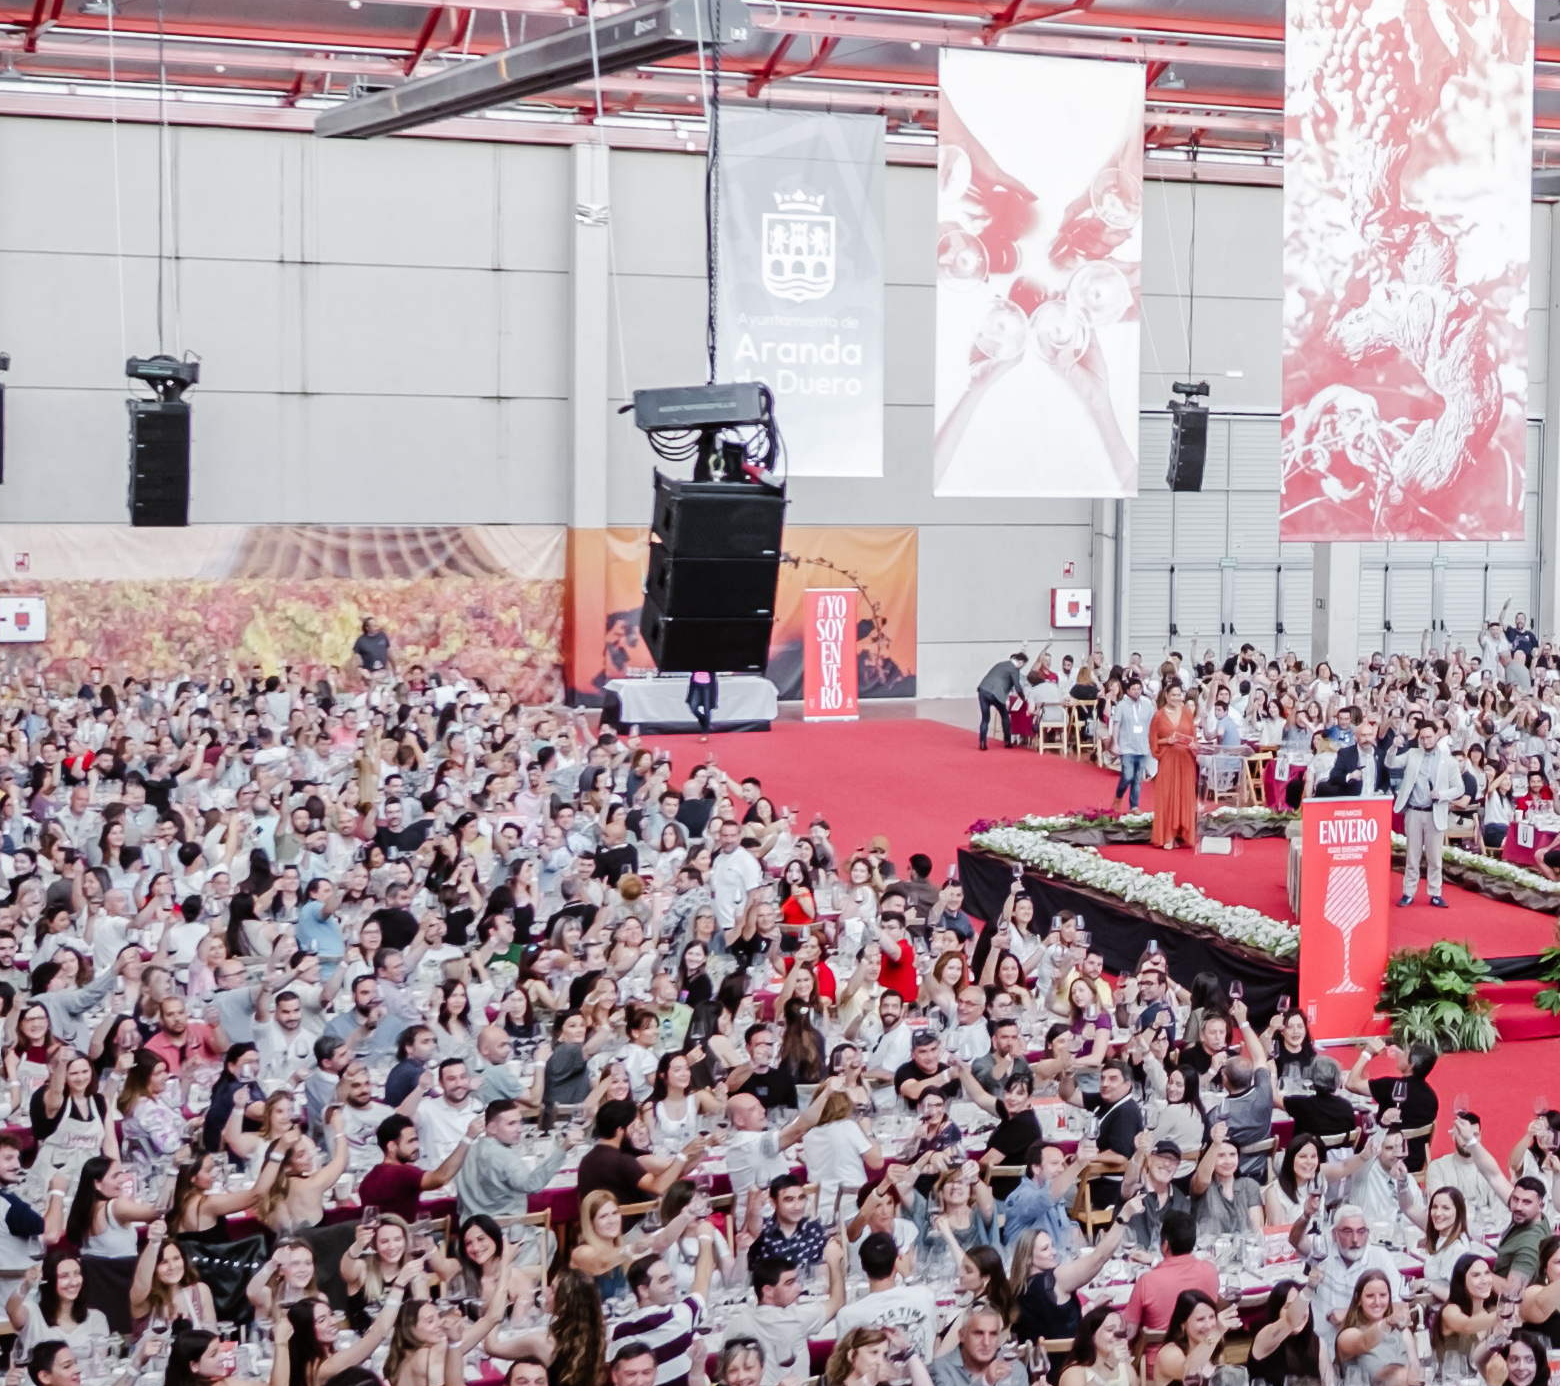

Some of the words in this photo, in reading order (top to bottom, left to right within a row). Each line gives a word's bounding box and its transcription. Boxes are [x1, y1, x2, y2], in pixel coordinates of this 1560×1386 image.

[739, 312, 839, 330] Ayuntamiento
[842, 315, 860, 329] de
[733, 333, 863, 366] Aranda
[776, 369, 863, 397] Duero
[817, 595, 847, 618] #YO
[816, 618, 847, 642] SOY
[821, 642, 841, 664] EN
[821, 664, 842, 687] VE
[820, 686, 843, 710] RO
[1318, 818, 1378, 845] ENVERO
